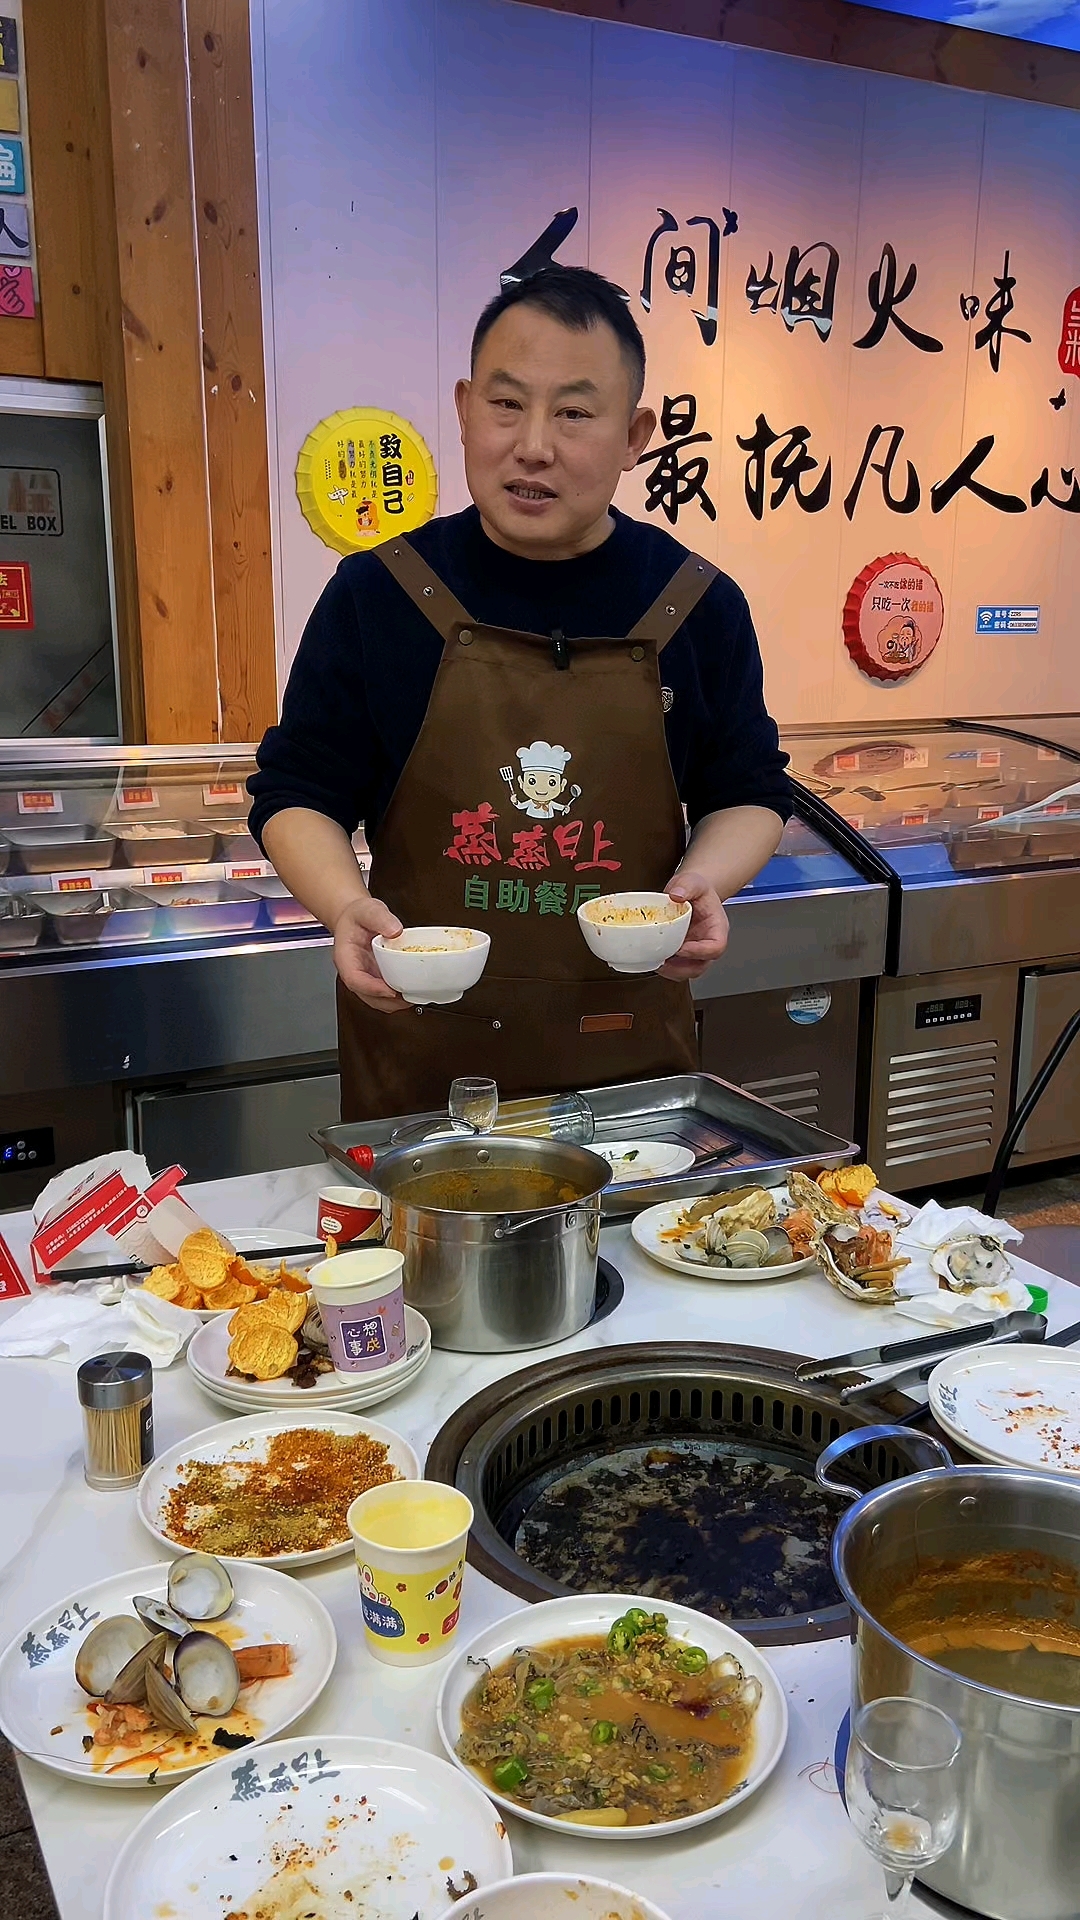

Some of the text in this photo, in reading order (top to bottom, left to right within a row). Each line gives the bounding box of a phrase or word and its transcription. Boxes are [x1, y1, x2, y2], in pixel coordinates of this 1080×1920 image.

[379, 433, 404, 514] 致自己
[27, 515, 57, 531] BOX
[443, 802, 622, 871] 蒸蒸日上
[20, 1602, 101, 1670] 蒸蒸日上
[229, 1748, 341, 1803] 蒸蒸日上
